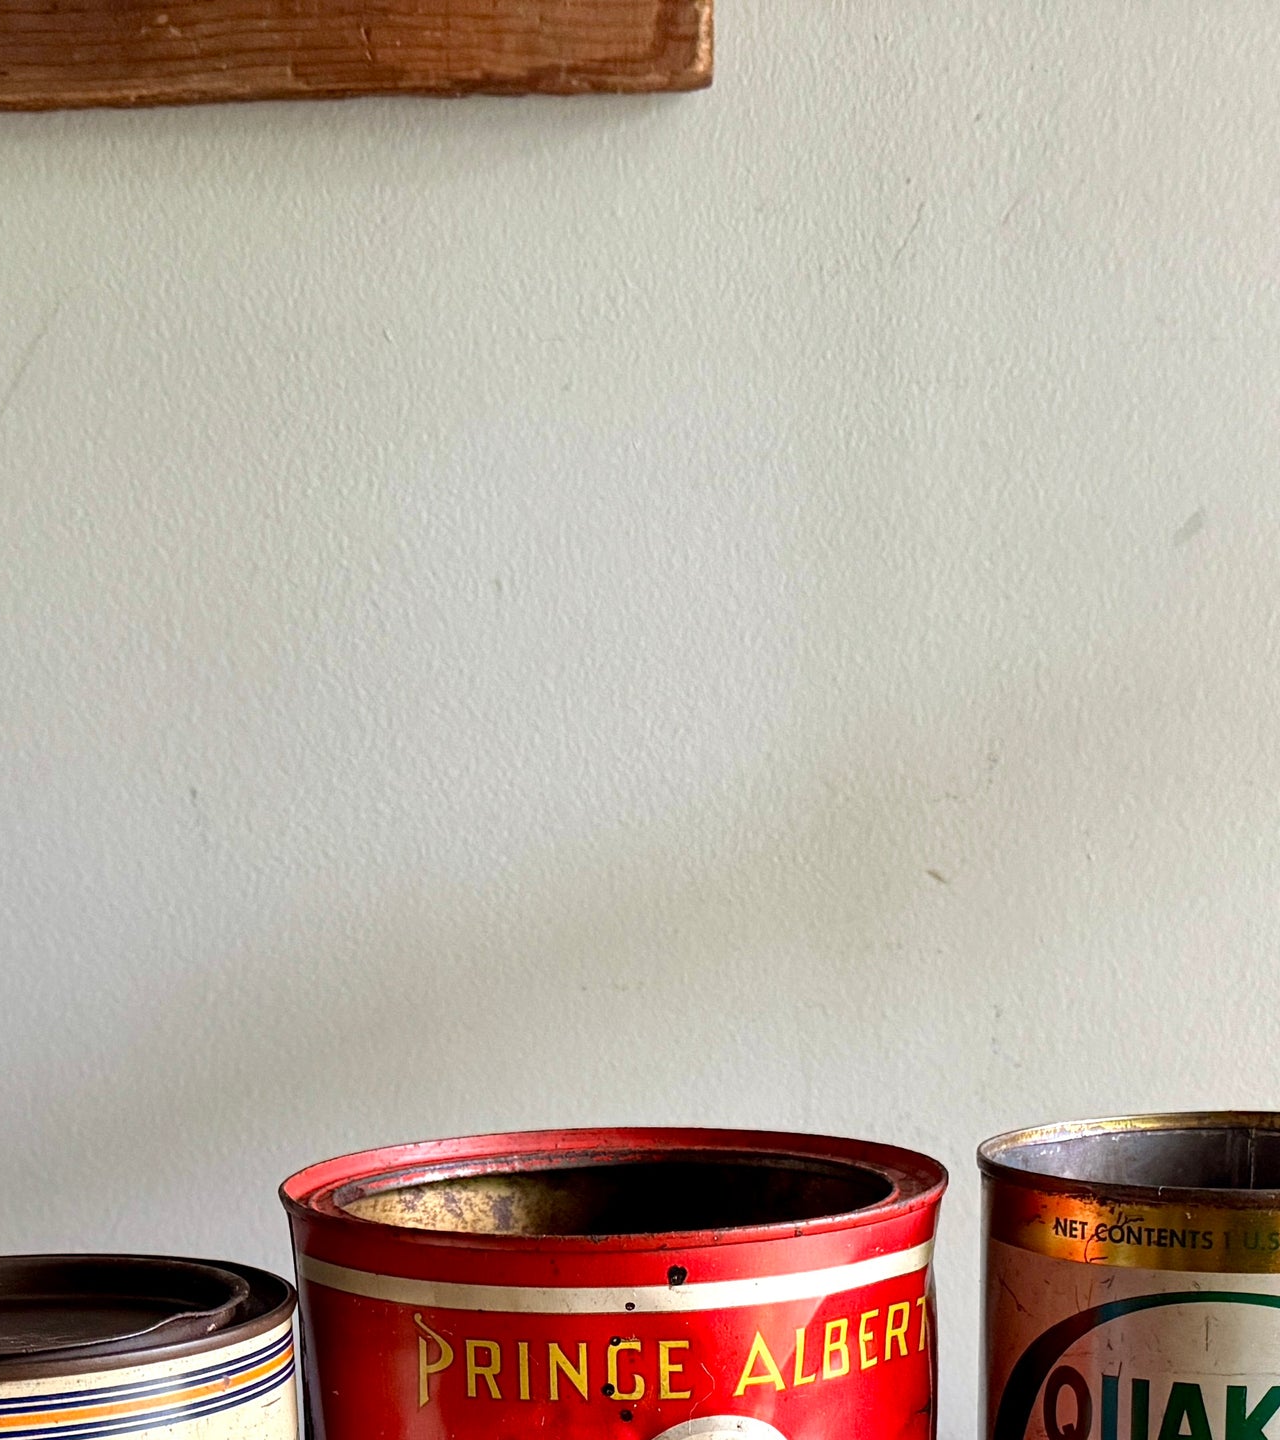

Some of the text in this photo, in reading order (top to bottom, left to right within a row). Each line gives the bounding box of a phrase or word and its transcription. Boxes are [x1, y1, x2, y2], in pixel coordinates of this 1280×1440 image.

[1053, 1217, 1088, 1240] NET
[1095, 1223, 1213, 1250] CONTENTS
[414, 1295, 928, 1408] PRINCE ALBERT
